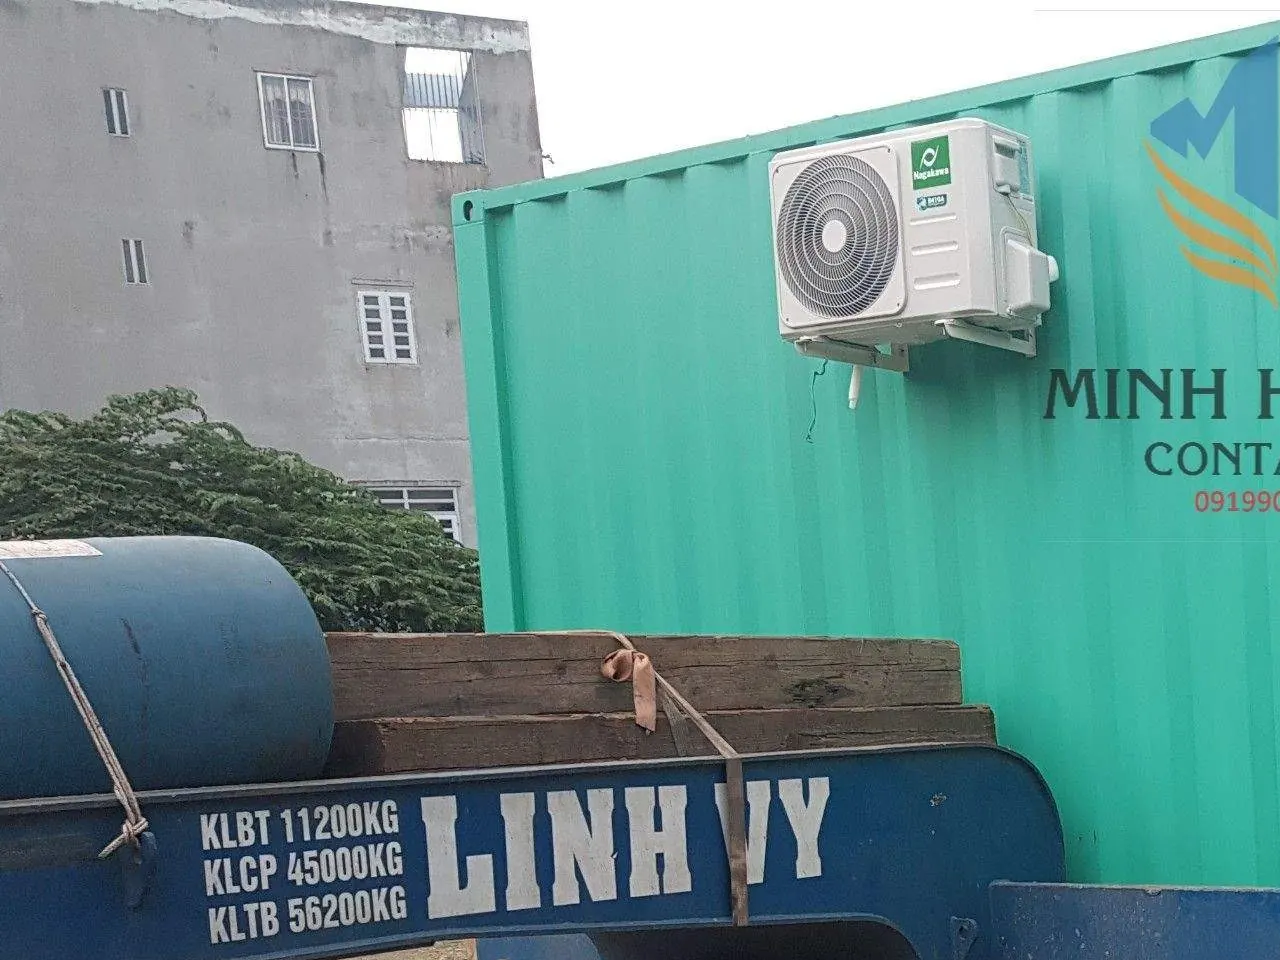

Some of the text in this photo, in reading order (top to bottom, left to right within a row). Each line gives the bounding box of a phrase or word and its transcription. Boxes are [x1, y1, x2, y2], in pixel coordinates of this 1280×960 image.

[200, 800, 400, 851] KLBT 11200KG
[420, 777, 832, 920] LINH VY
[204, 841, 404, 896] KLCP 45000KG
[208, 885, 408, 945] KLTB 56200KG
